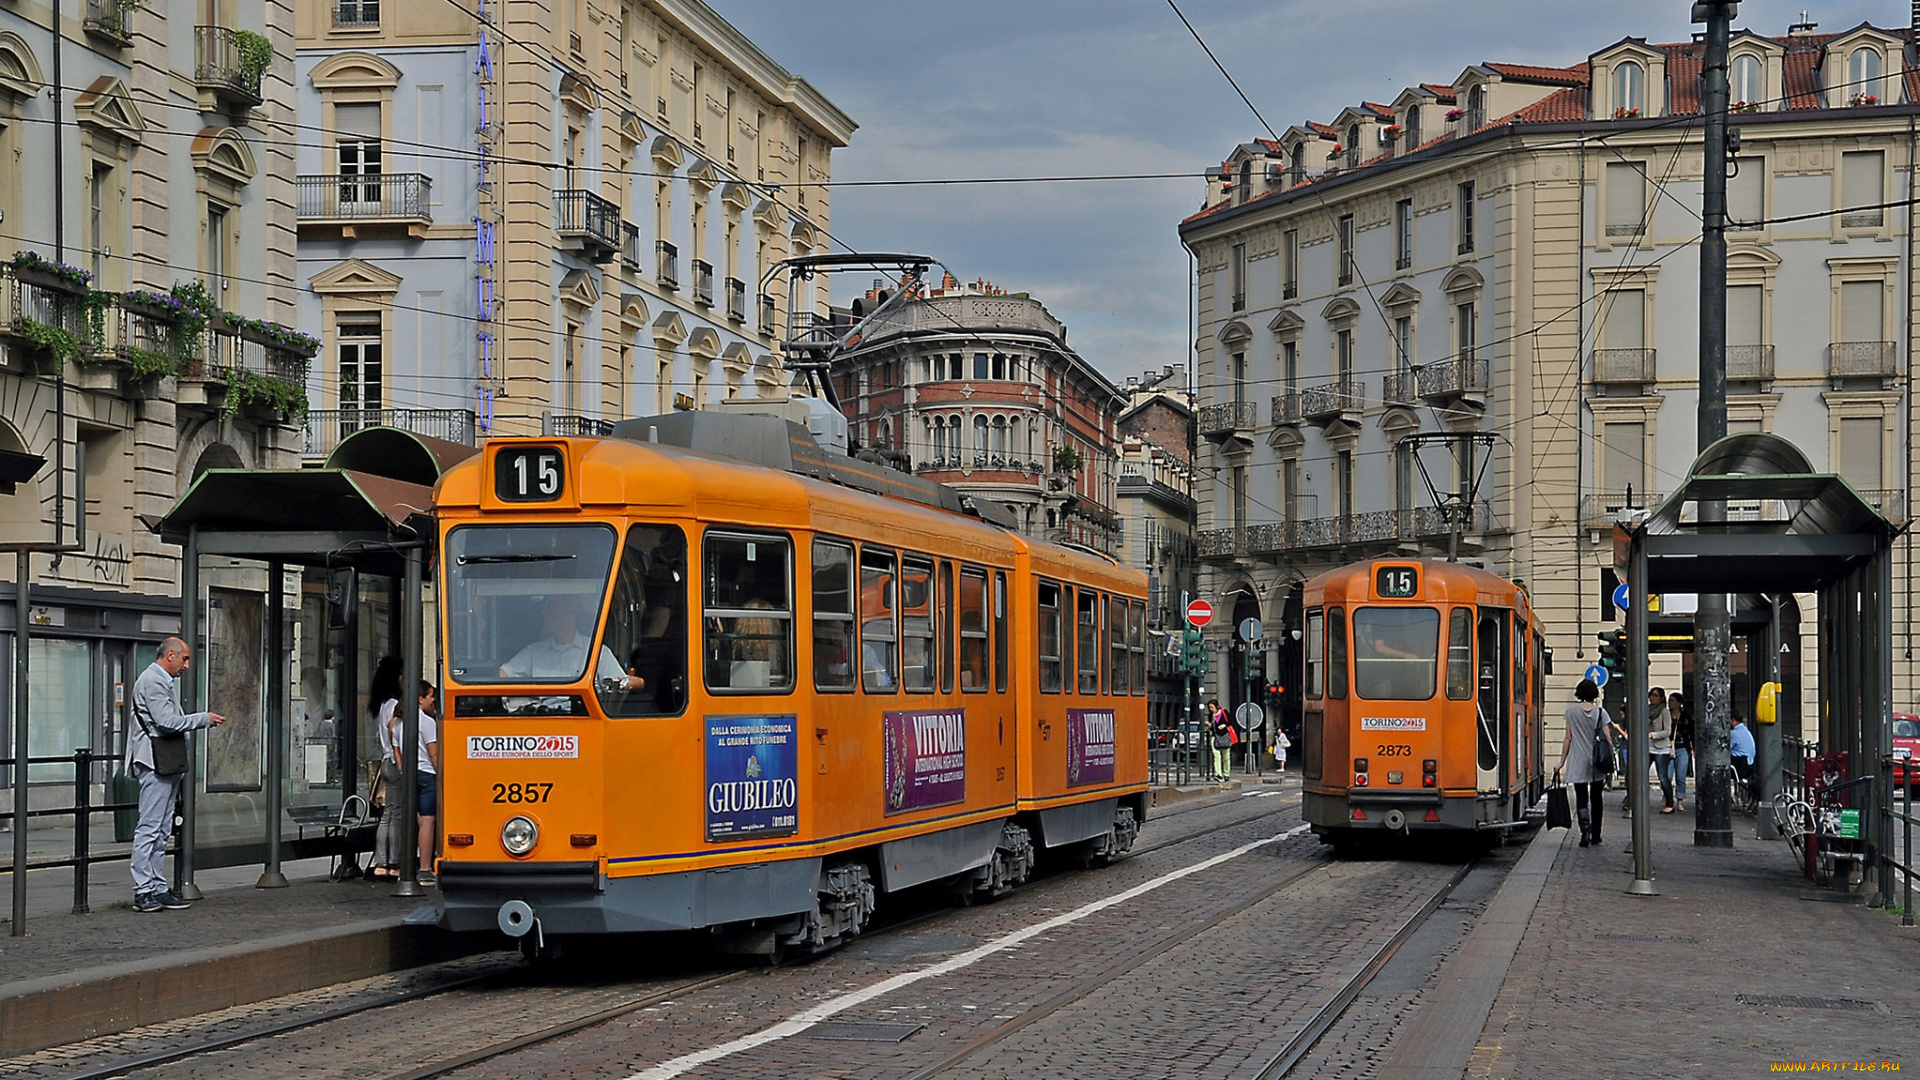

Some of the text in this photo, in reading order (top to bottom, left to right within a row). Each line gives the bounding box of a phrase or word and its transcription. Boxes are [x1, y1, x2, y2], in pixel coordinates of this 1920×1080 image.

[514, 455, 558, 495] 15
[1386, 571, 1411, 593] 15
[711, 724, 792, 736] DALLA CERIMONIA ECONOMICA
[912, 713, 964, 756] VITTORIA
[1083, 713, 1114, 744] VITTORIA
[718, 735, 787, 747] AL GRANDE RITO FUNEBRE
[1377, 744, 1412, 756] 2873
[492, 782, 554, 804] 2857
[709, 777, 796, 814] GIUBILEO
